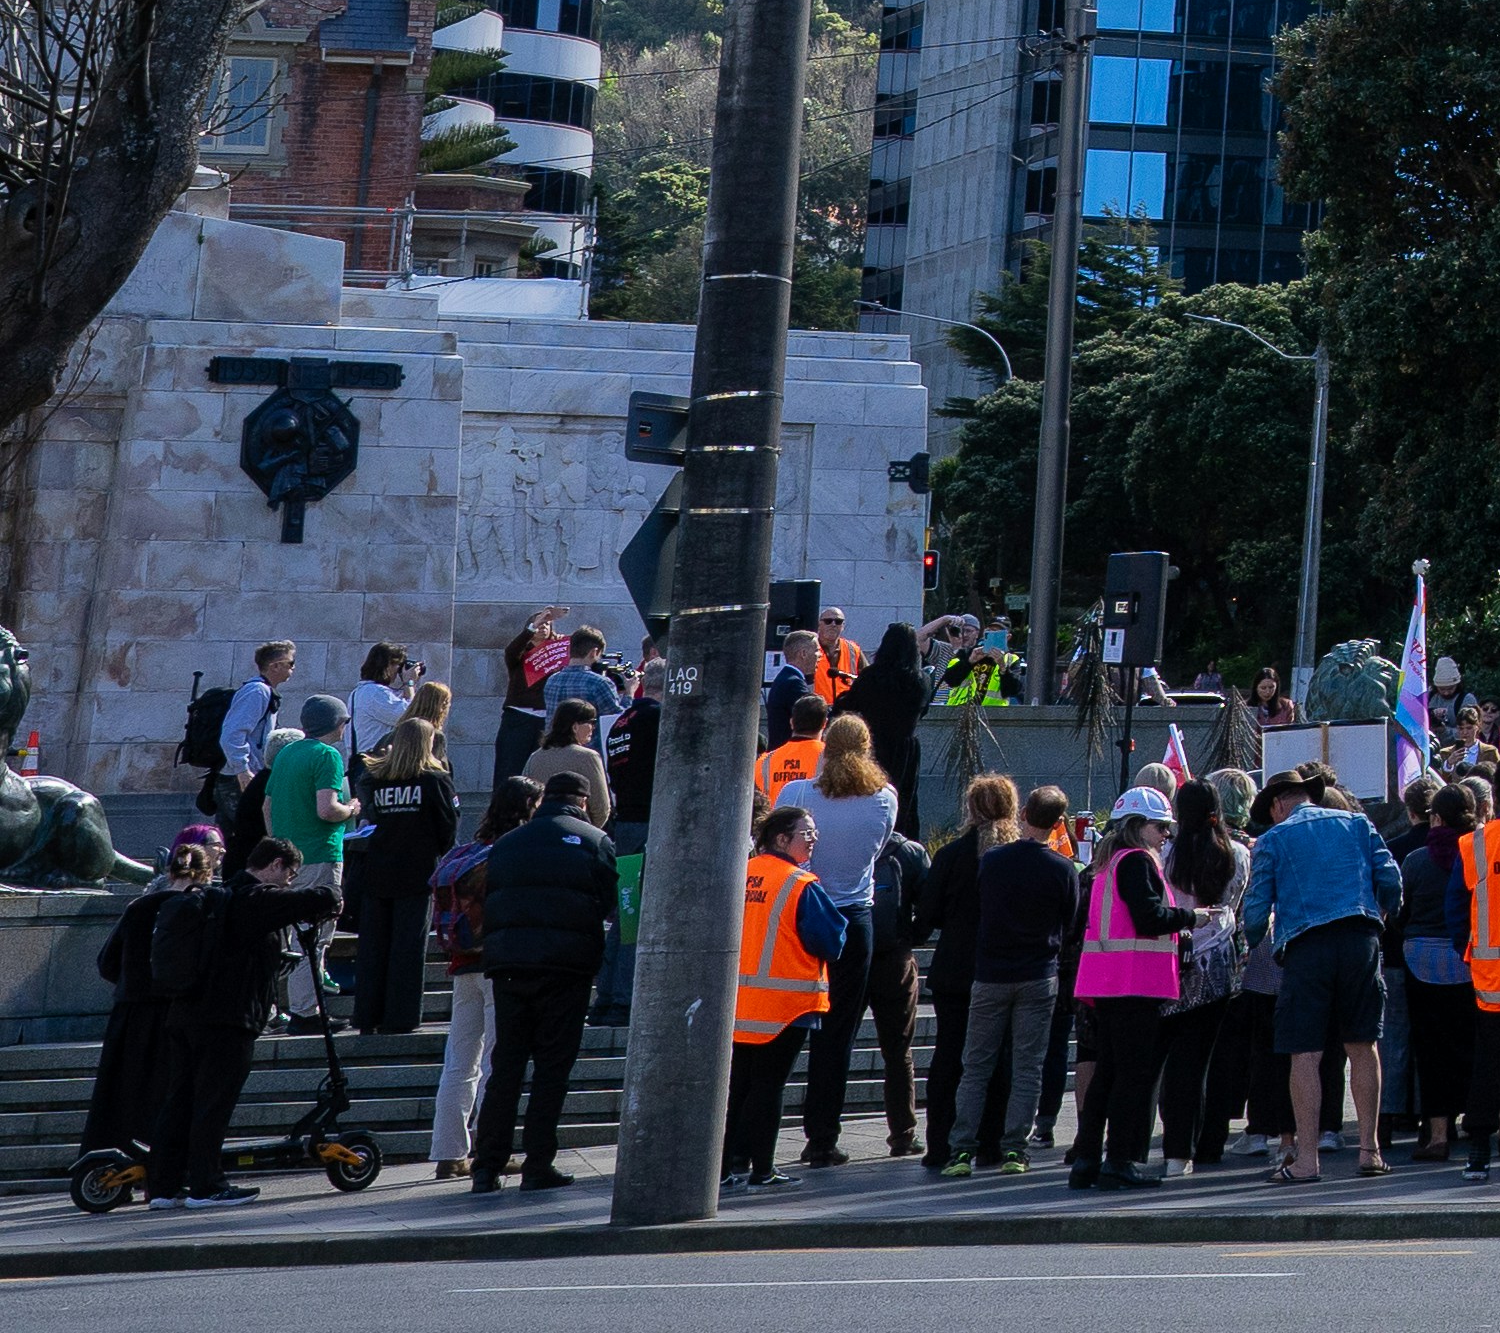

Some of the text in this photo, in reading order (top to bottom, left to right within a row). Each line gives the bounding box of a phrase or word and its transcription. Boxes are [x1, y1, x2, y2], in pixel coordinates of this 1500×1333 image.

[668, 667, 698, 682] LAQ
[668, 681, 693, 695] 419
[784, 759, 800, 770] PSA
[374, 785, 422, 806] NEMA
